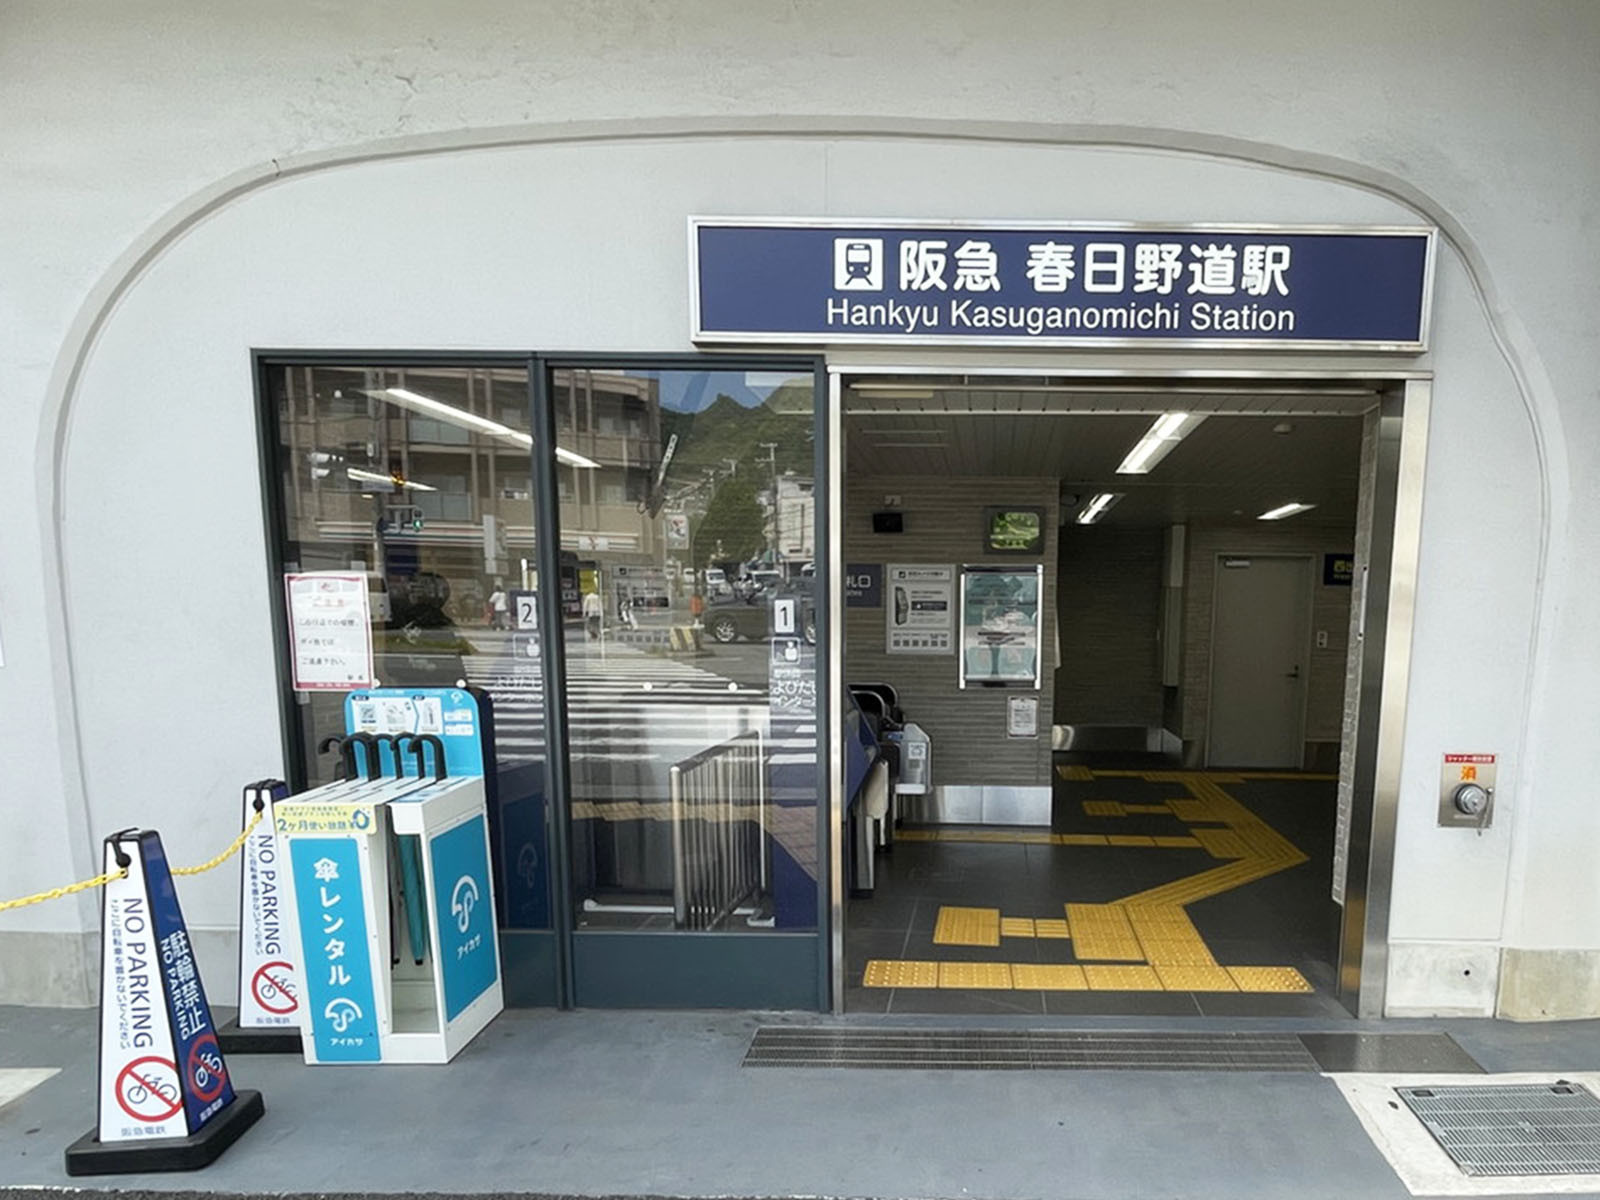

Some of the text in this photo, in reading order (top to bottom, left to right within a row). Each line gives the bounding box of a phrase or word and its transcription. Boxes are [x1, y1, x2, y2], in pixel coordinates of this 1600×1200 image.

[900, 239, 1291, 296] 阪急 春日野道駅
[827, 298, 1295, 335] Hankyu Kasuganomichi Station
[521, 602, 533, 624] 2
[779, 606, 789, 627] 1
[258, 835, 281, 955] NO PARKING
[313, 857, 352, 986] 傘レンタル
[457, 933, 481, 961] アイカサ
[123, 898, 153, 1049] NO PARKING
[160, 937, 190, 1041] NO PARKING
[329, 1037, 364, 1047] アイカサ
